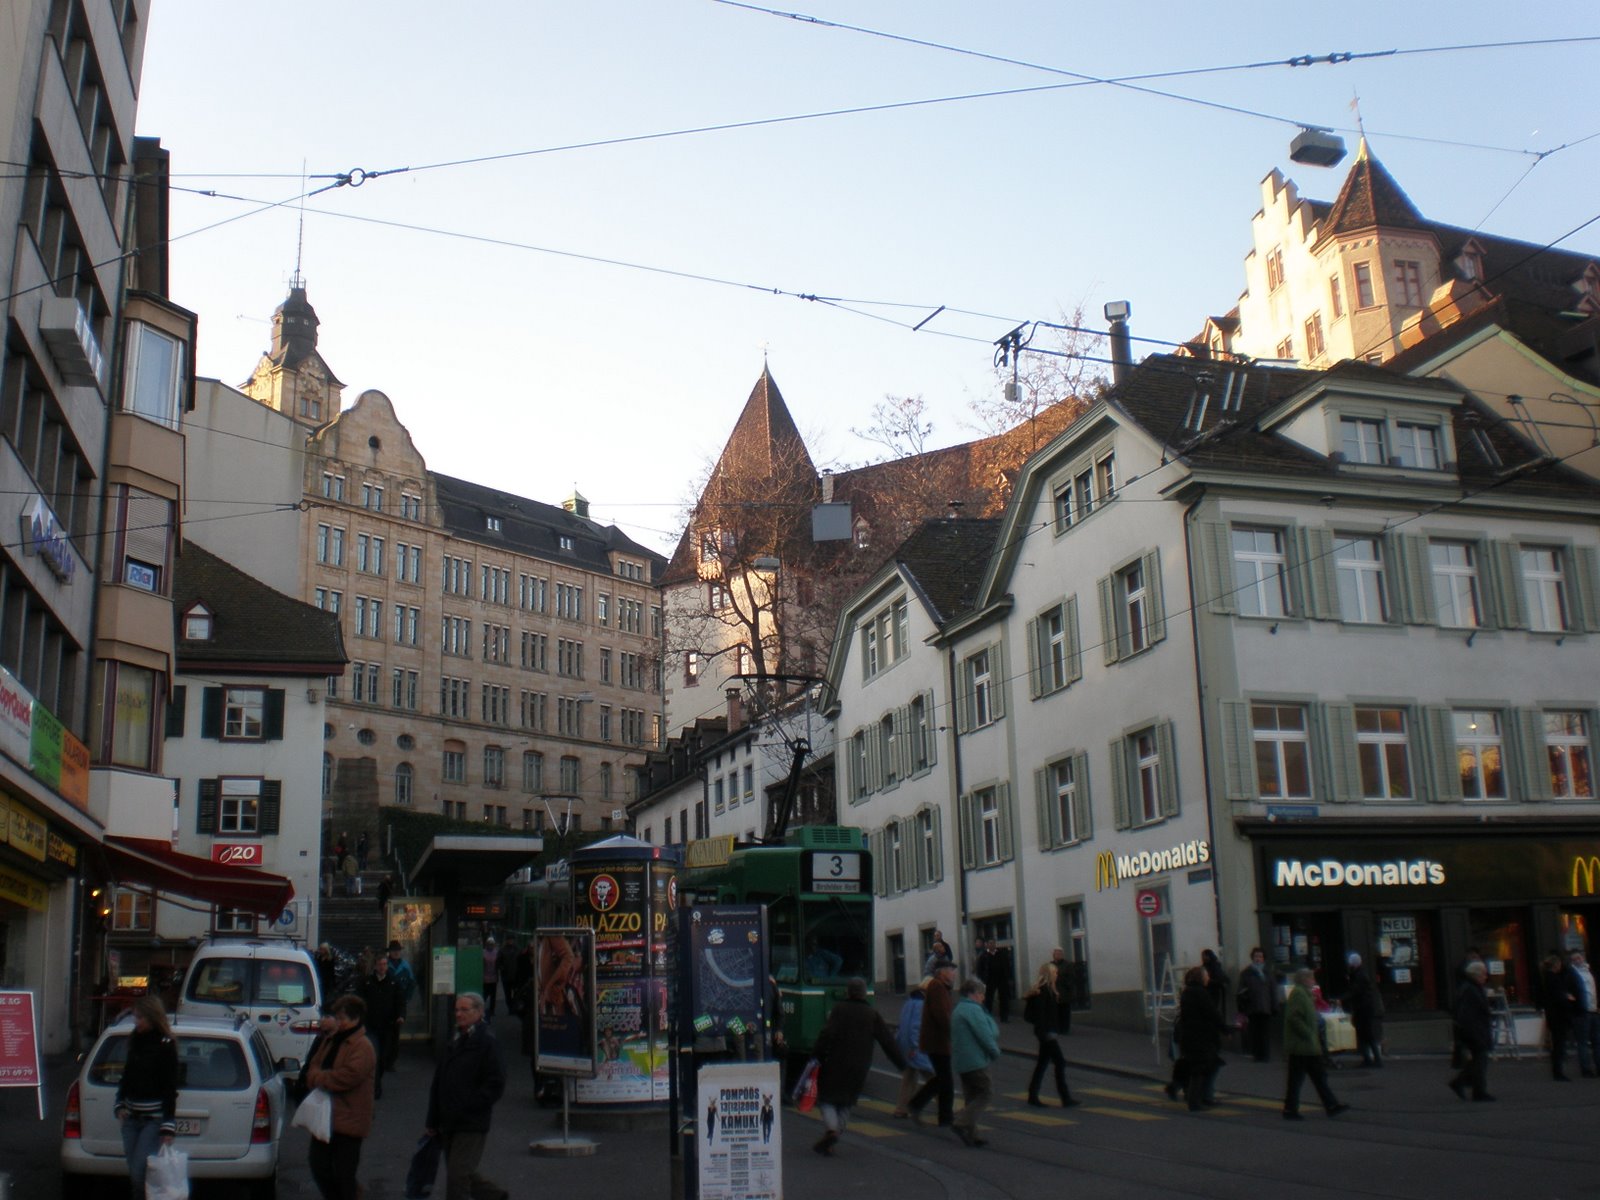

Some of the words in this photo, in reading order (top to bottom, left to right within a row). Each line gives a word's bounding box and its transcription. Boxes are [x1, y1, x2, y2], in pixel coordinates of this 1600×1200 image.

[829, 855, 844, 877] 3
[1117, 839, 1211, 879] McDonald's
[1275, 860, 1446, 888] McDonald's
[1382, 919, 1416, 930] NEU!
